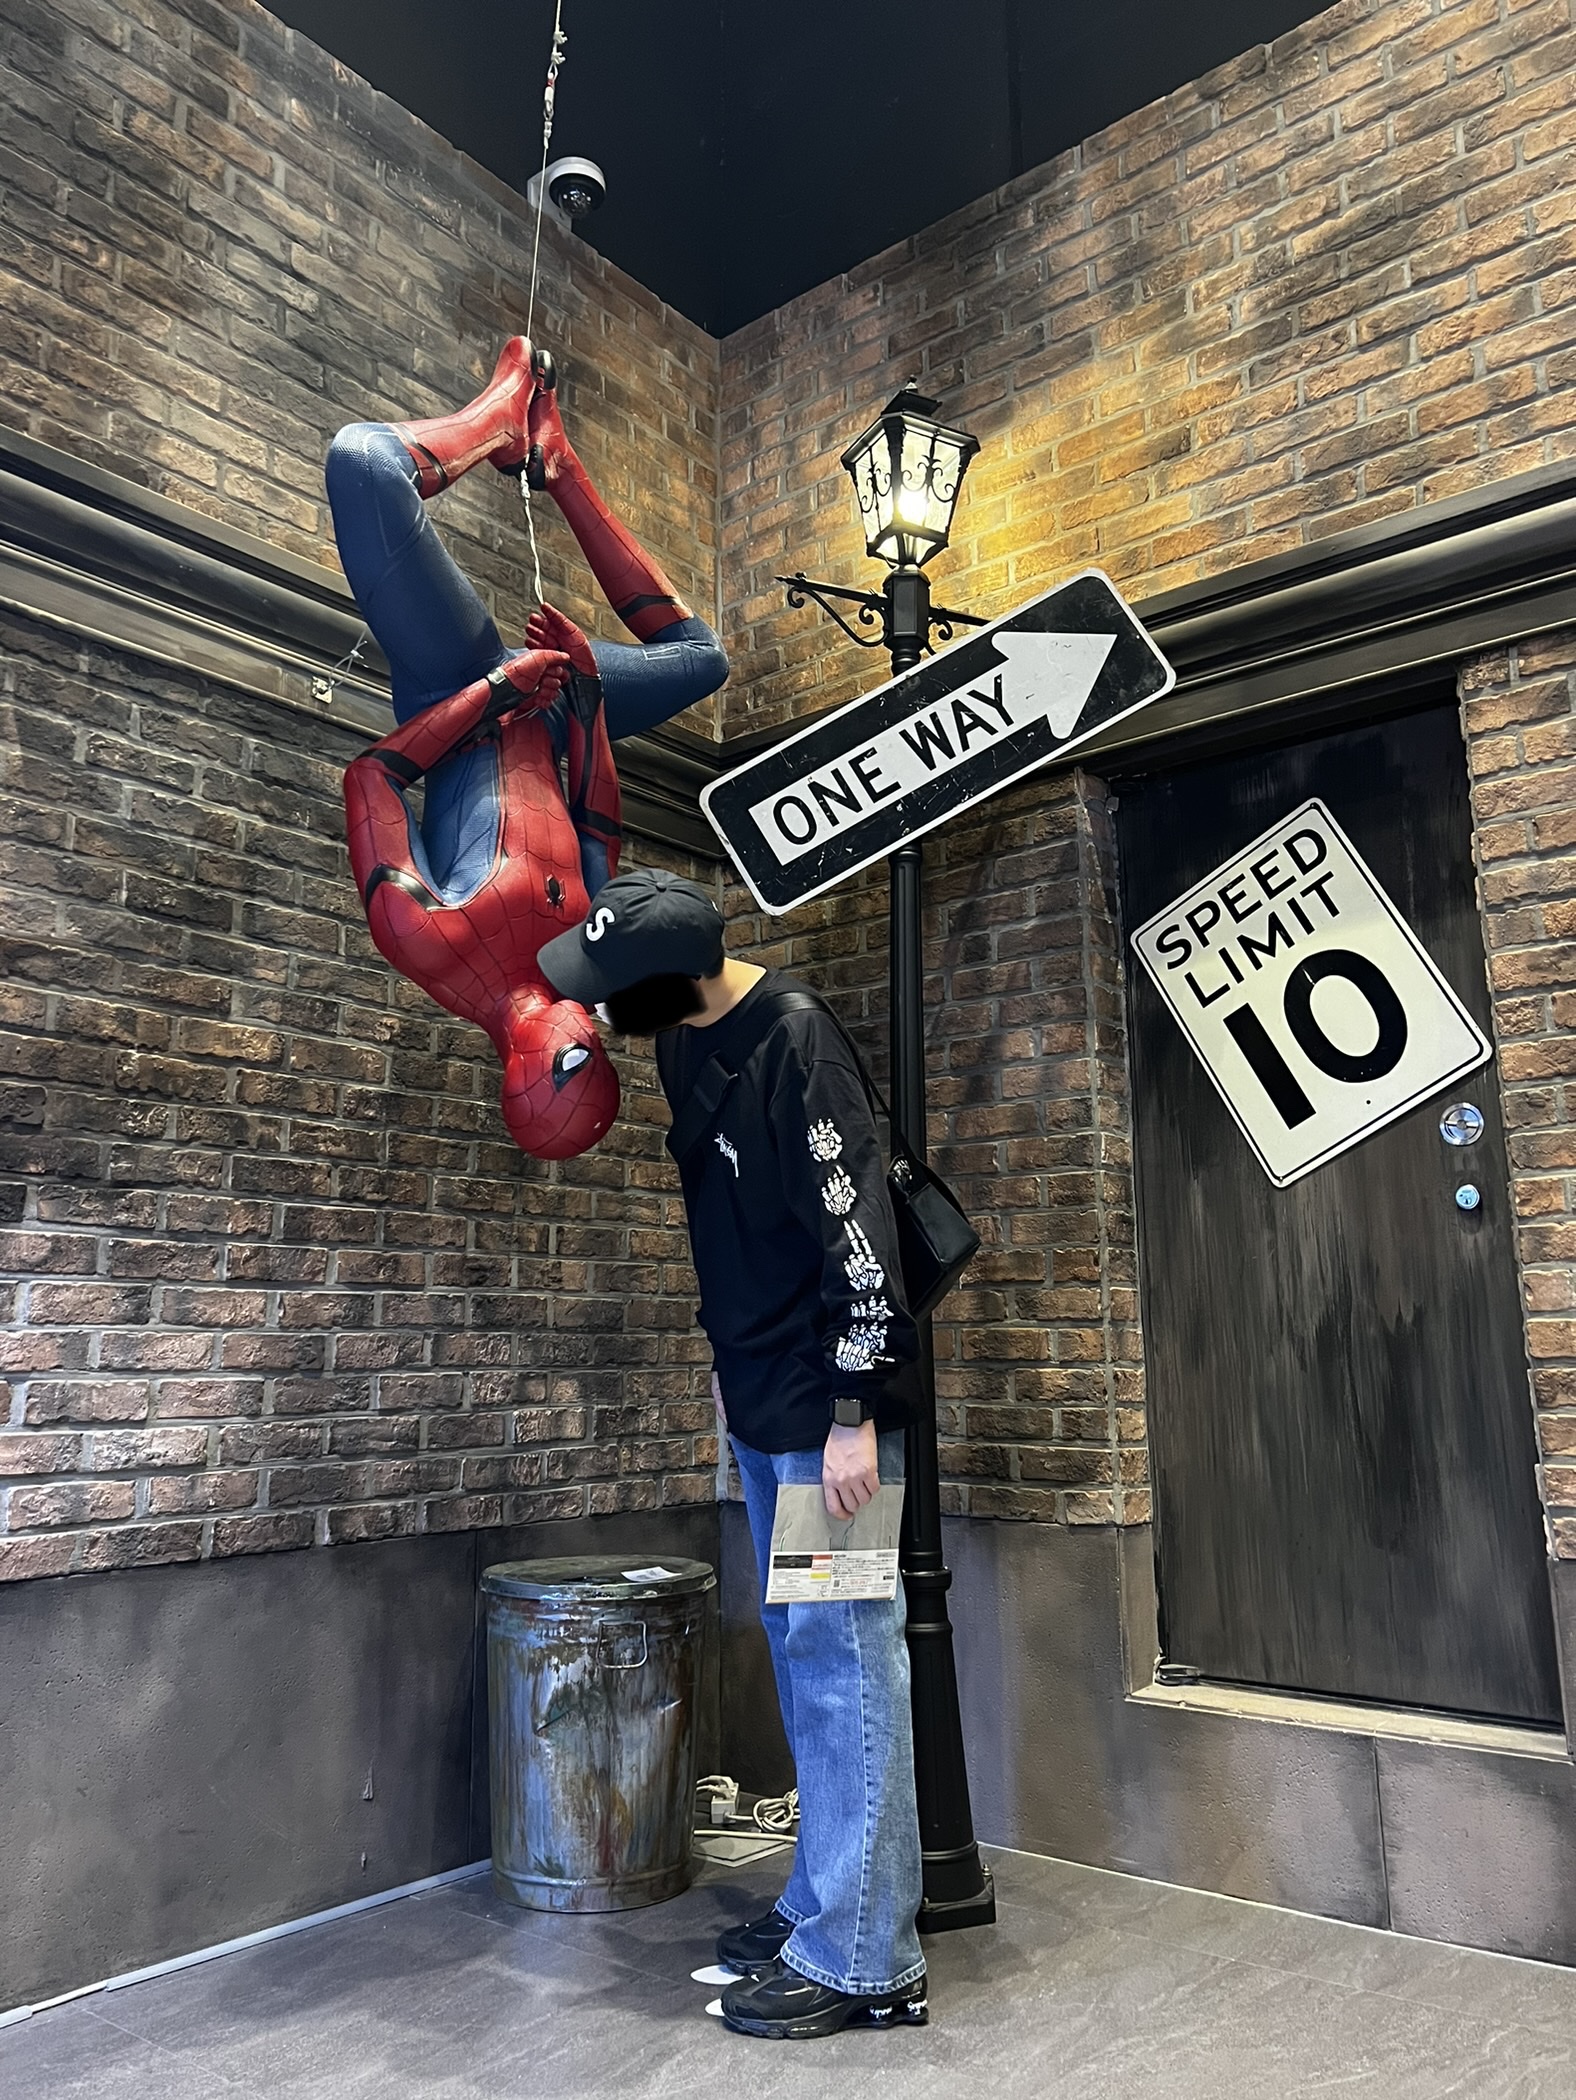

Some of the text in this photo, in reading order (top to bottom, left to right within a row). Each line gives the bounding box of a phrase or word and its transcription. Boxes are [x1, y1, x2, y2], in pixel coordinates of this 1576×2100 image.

[772, 674, 1015, 845] ONE WAY
[585, 907, 616, 942] S
[1155, 828, 1328, 970] SPEED
[1184, 871, 1340, 1009] LIMIT
[1222, 948, 1408, 1131] 10
